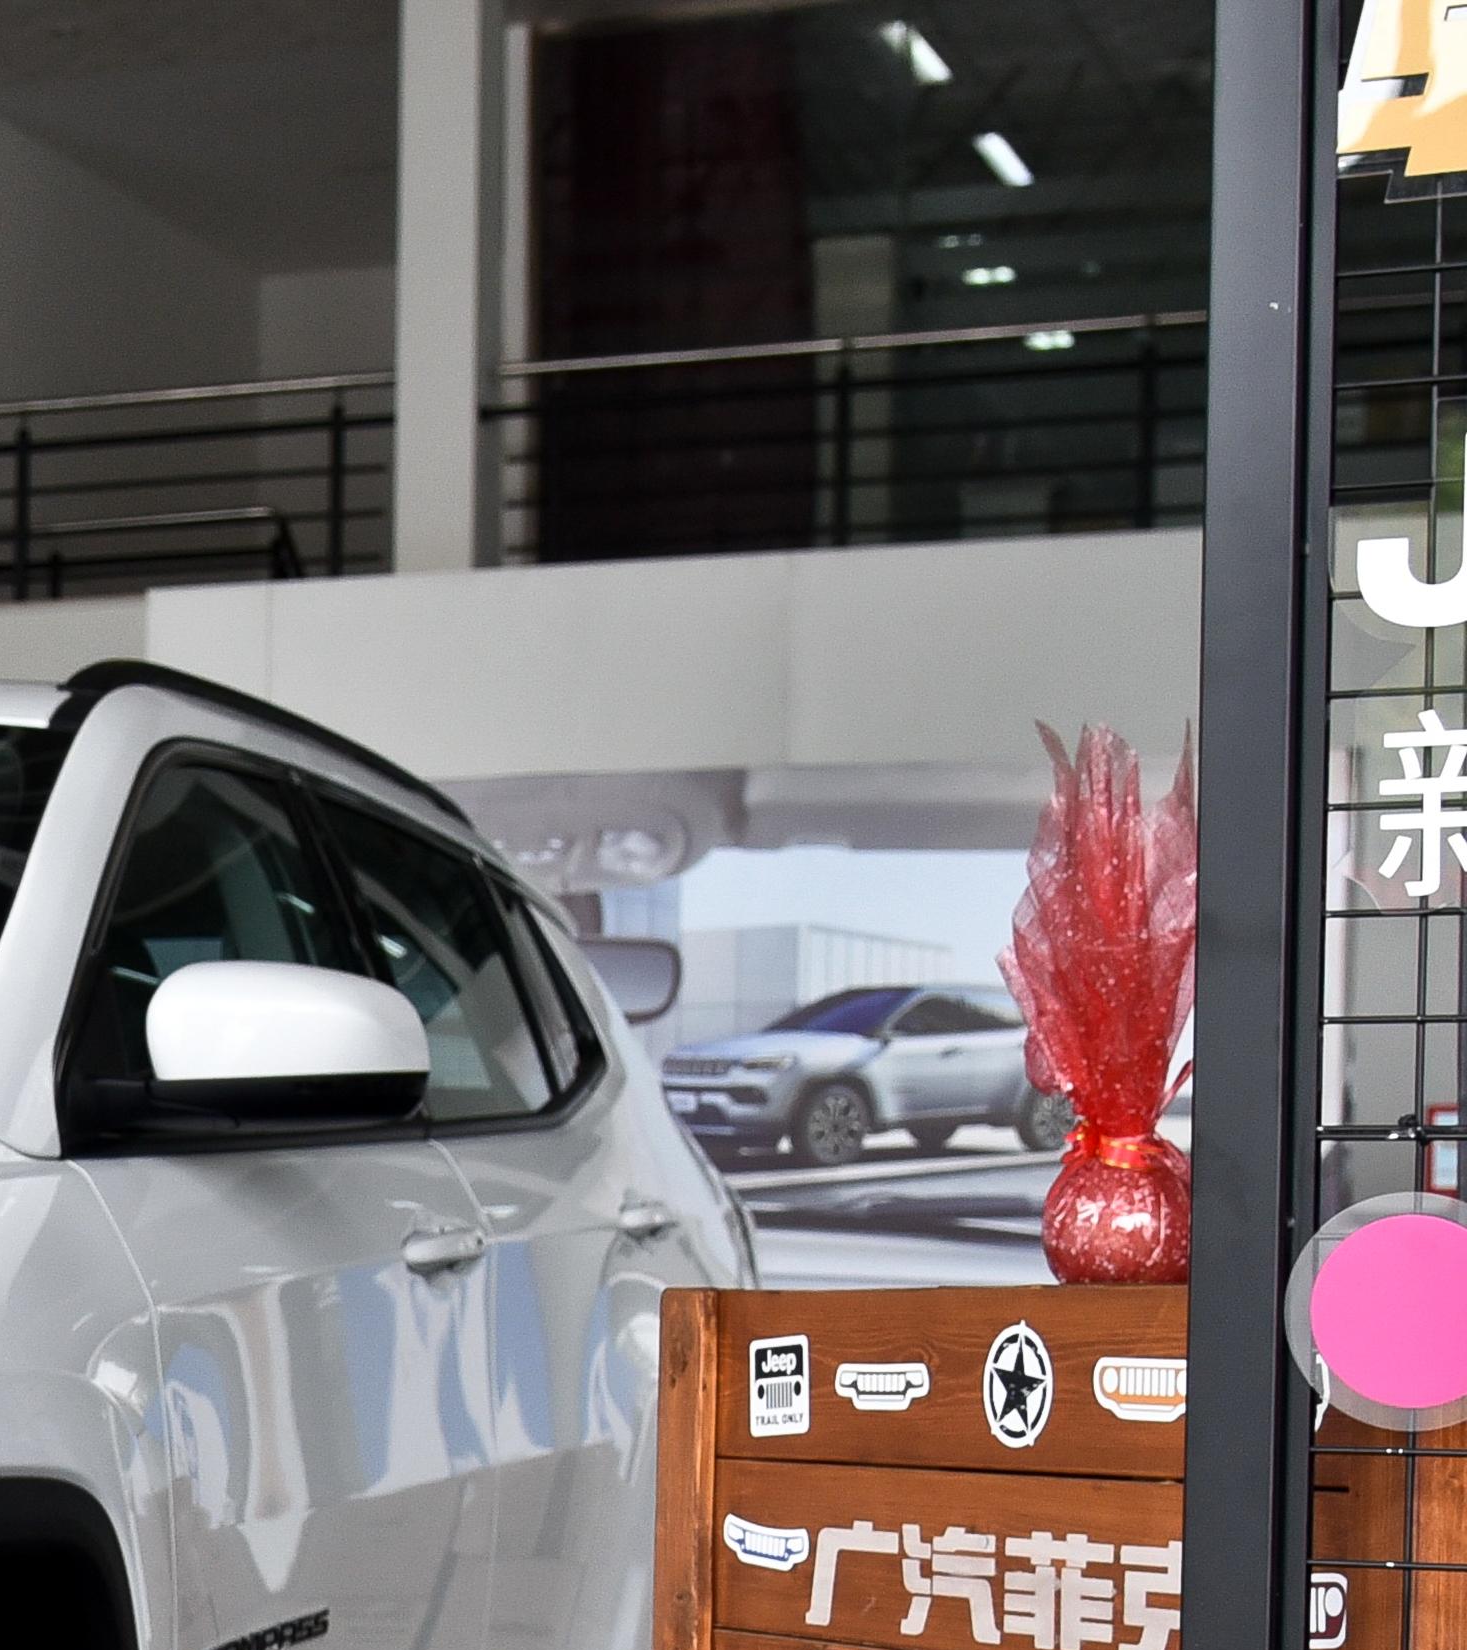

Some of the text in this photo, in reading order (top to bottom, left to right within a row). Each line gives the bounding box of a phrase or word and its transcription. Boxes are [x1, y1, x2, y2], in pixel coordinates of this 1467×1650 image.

[761, 1349, 797, 1375] Jeep
[755, 1413, 804, 1426] TRAIL ONLY
